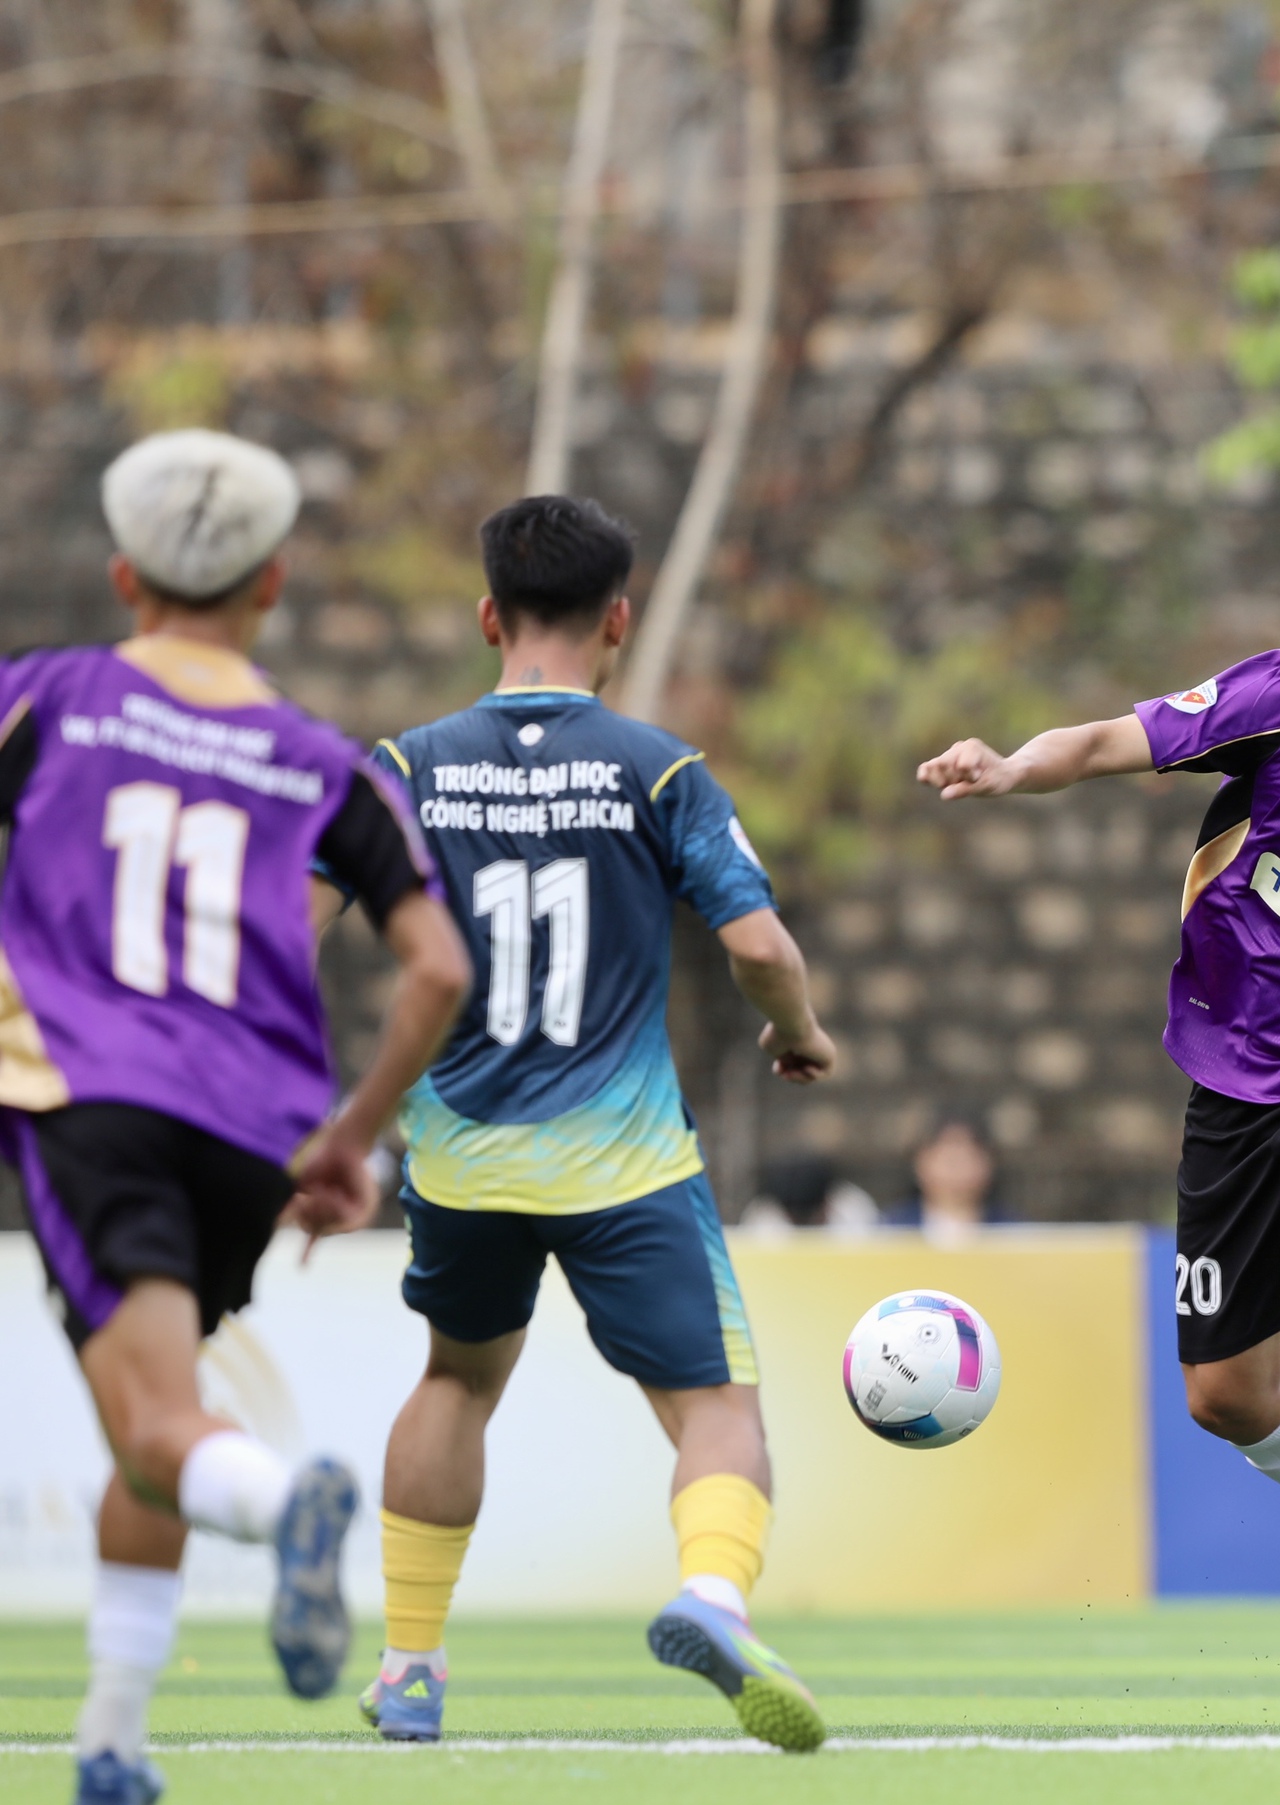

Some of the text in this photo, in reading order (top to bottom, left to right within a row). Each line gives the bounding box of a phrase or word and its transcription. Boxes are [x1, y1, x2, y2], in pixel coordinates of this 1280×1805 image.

[433, 760, 622, 799] TRƯỜNG ĐẠI HỌC
[420, 795, 635, 838] CÔNG NGHỆ TP.HCM
[102, 780, 251, 1009] 11
[473, 856, 589, 1047] 11
[1175, 1252, 1222, 1316] 20
